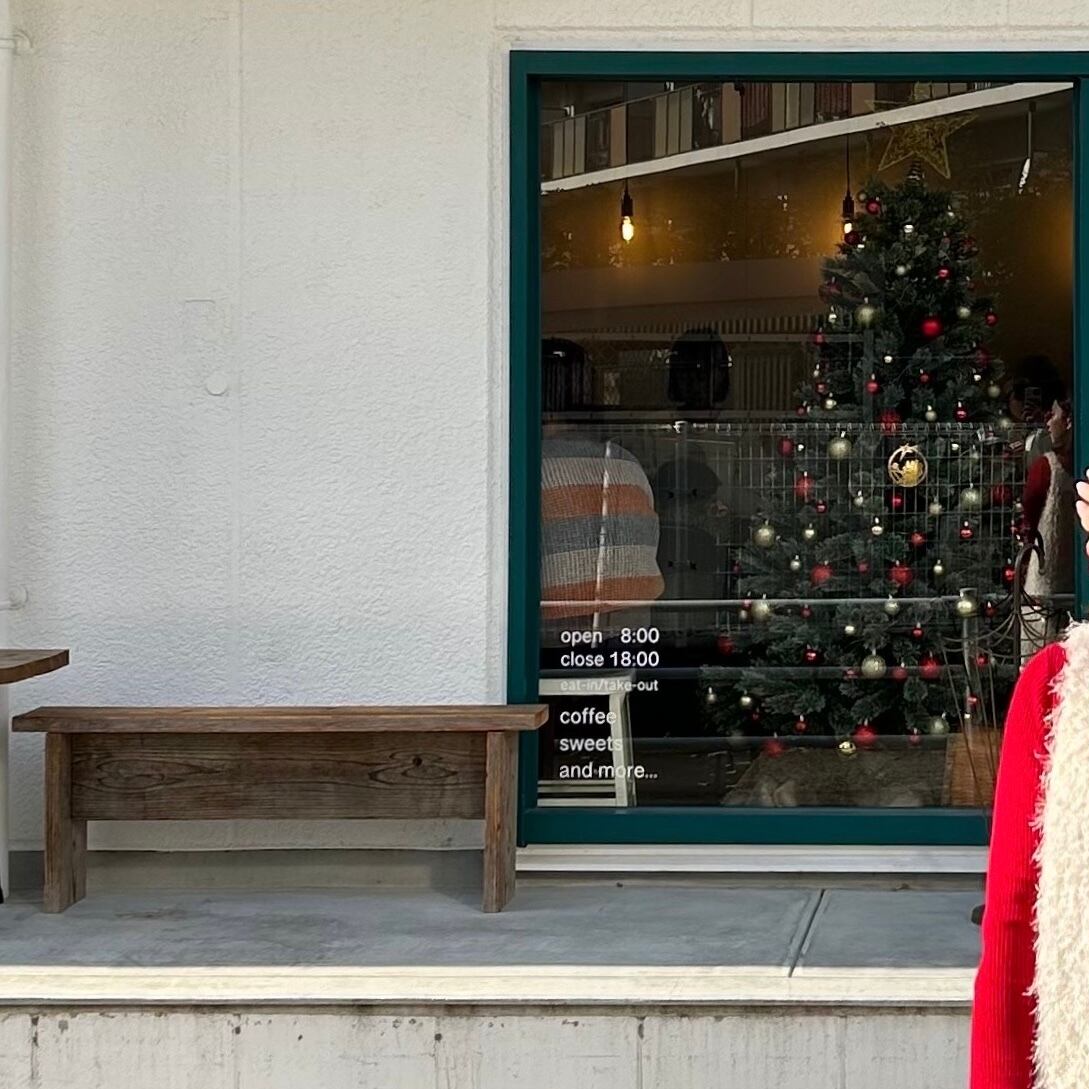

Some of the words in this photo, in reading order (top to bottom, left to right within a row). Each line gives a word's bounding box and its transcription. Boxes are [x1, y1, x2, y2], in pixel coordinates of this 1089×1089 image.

[560, 631, 603, 647] open
[620, 627, 660, 644] 8:00
[560, 651, 605, 667] close
[609, 651, 660, 667] 18:00
[560, 679, 659, 692] eat-in/take-out
[560, 707, 618, 724] coffee
[559, 736, 623, 752] sweets
[559, 761, 594, 778] and
[598, 764, 658, 779] more...
